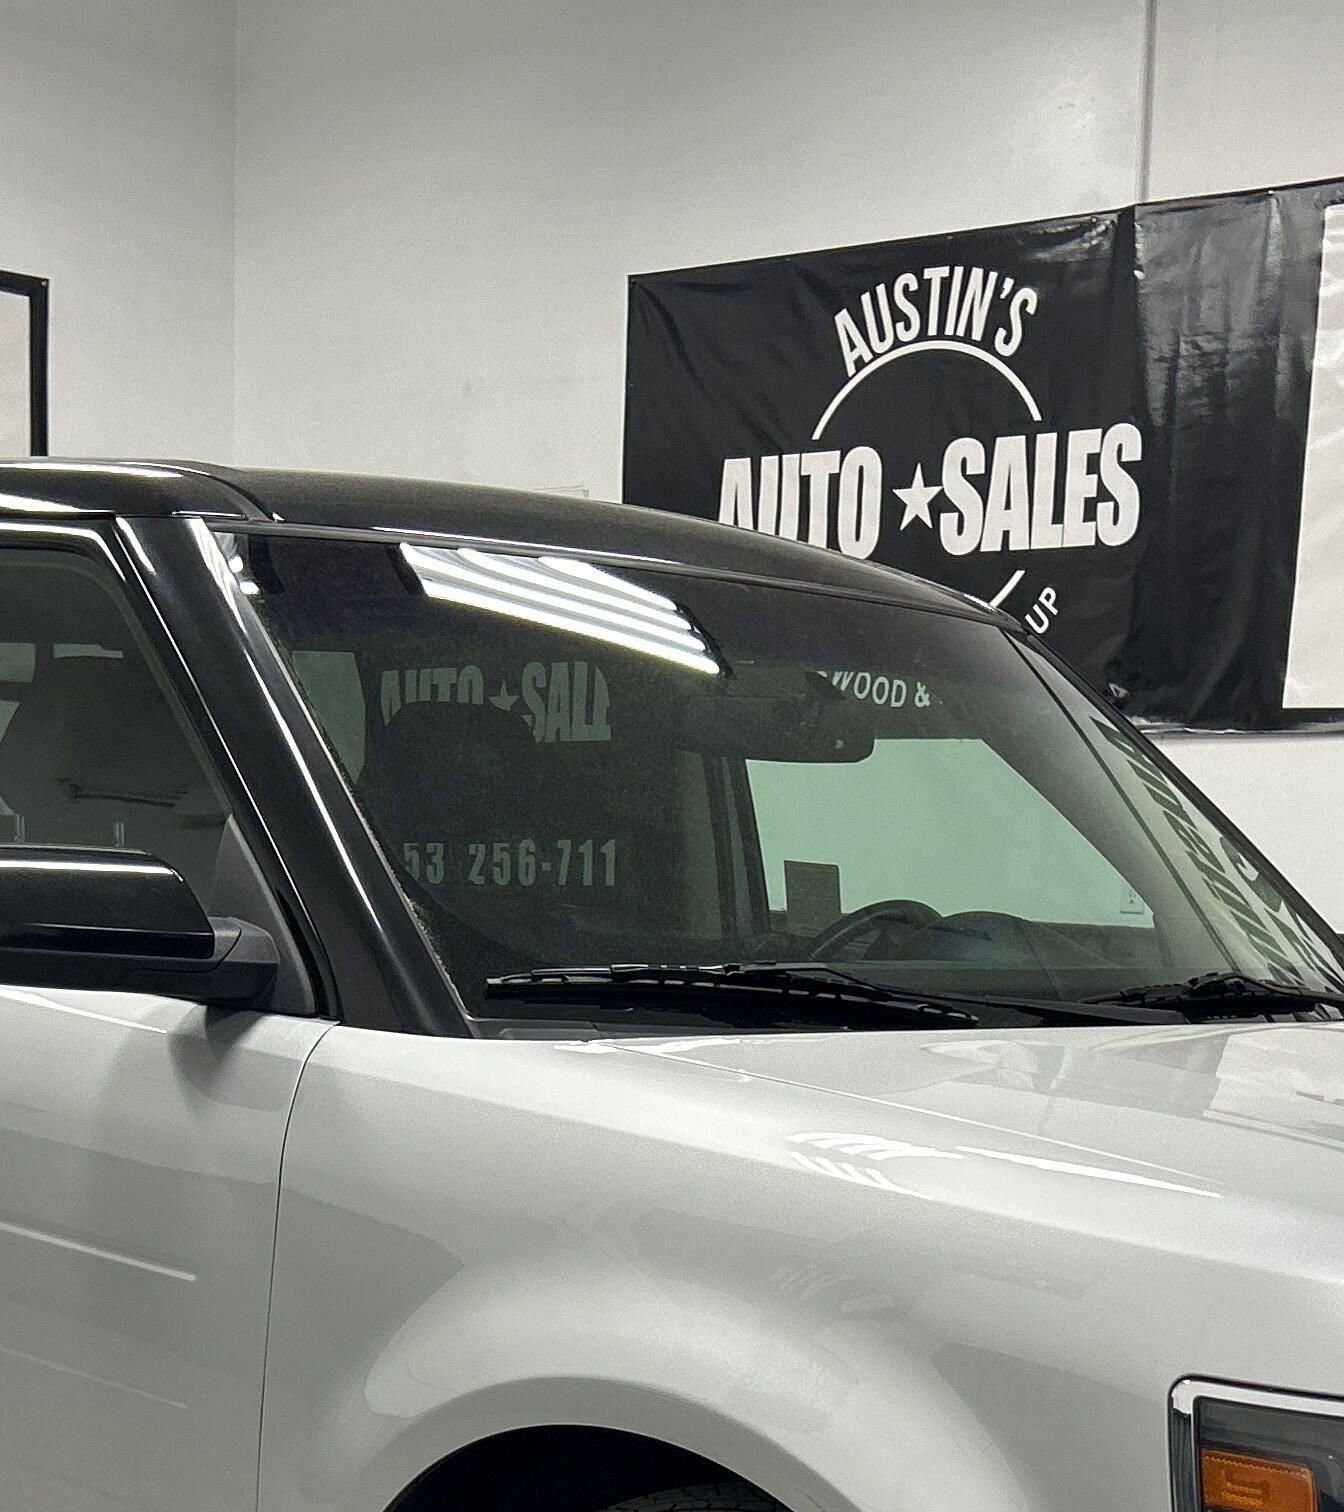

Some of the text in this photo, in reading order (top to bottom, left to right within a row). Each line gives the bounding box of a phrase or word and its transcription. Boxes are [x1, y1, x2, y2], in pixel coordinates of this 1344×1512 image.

[833, 265, 1038, 377] AUSTIN'S
[718, 422, 1143, 560] AUTO SALES
[817, 669, 907, 707] WOOD
